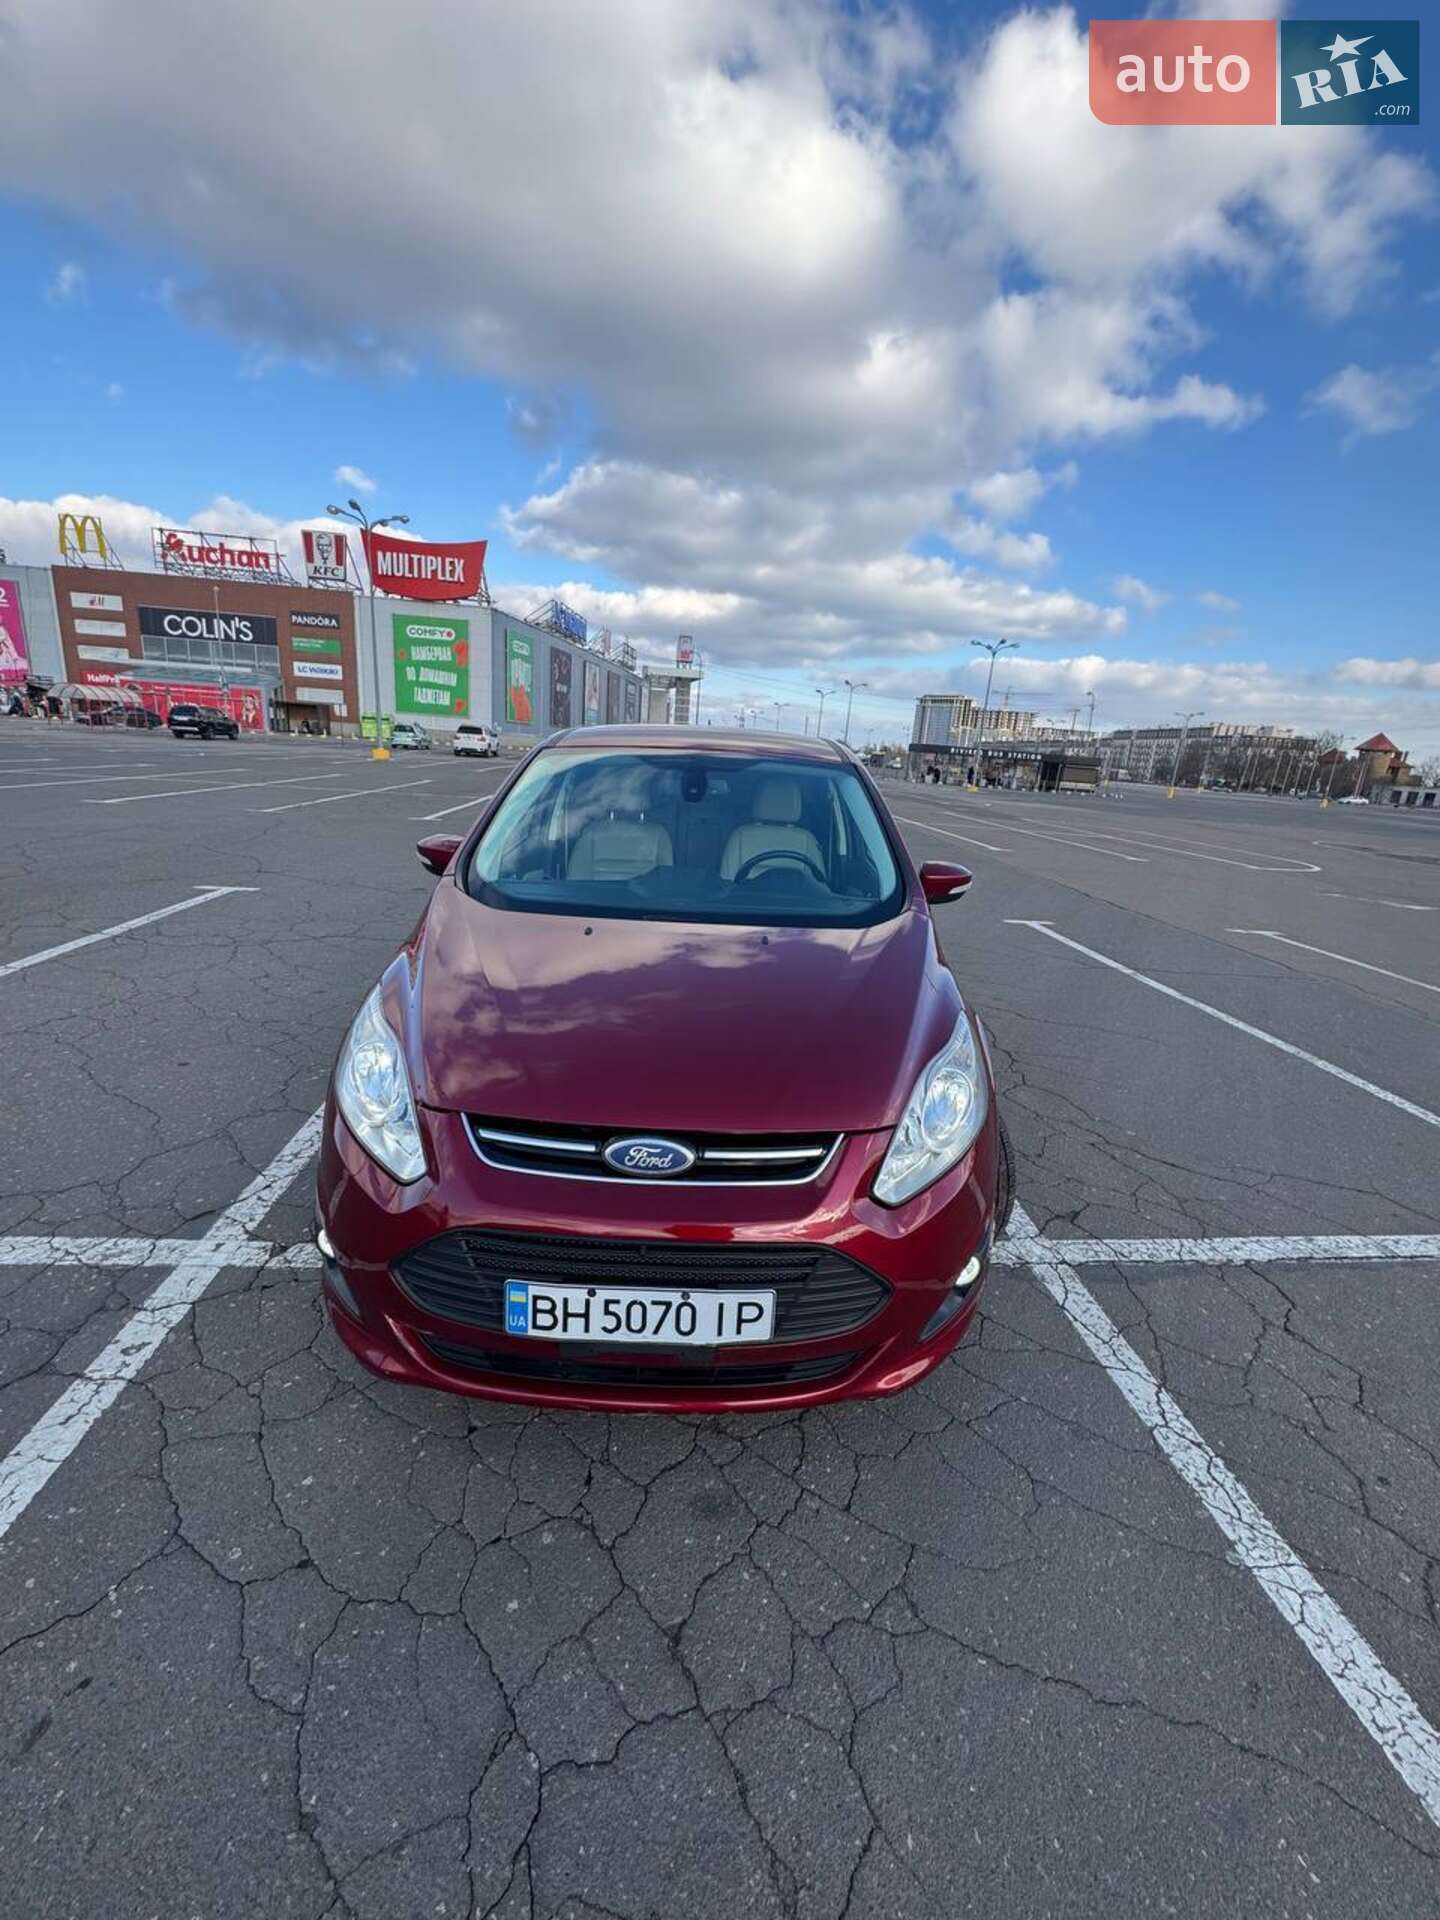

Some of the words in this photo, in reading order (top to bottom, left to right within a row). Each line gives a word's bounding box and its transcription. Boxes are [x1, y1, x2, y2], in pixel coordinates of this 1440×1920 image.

[160, 532, 272, 572] Auchan
[311, 565, 342, 578] KFC
[376, 550, 466, 583] MULTIPLEX
[163, 613, 254, 642] COLIN'S
[291, 614, 338, 628] PANDORA
[408, 627, 444, 638] COMFY
[624, 1145, 673, 1168] Ford
[509, 1314, 528, 1328] UA
[531, 1295, 591, 1334] BH
[600, 1298, 698, 1337] 5070
[716, 1301, 765, 1337] IP
